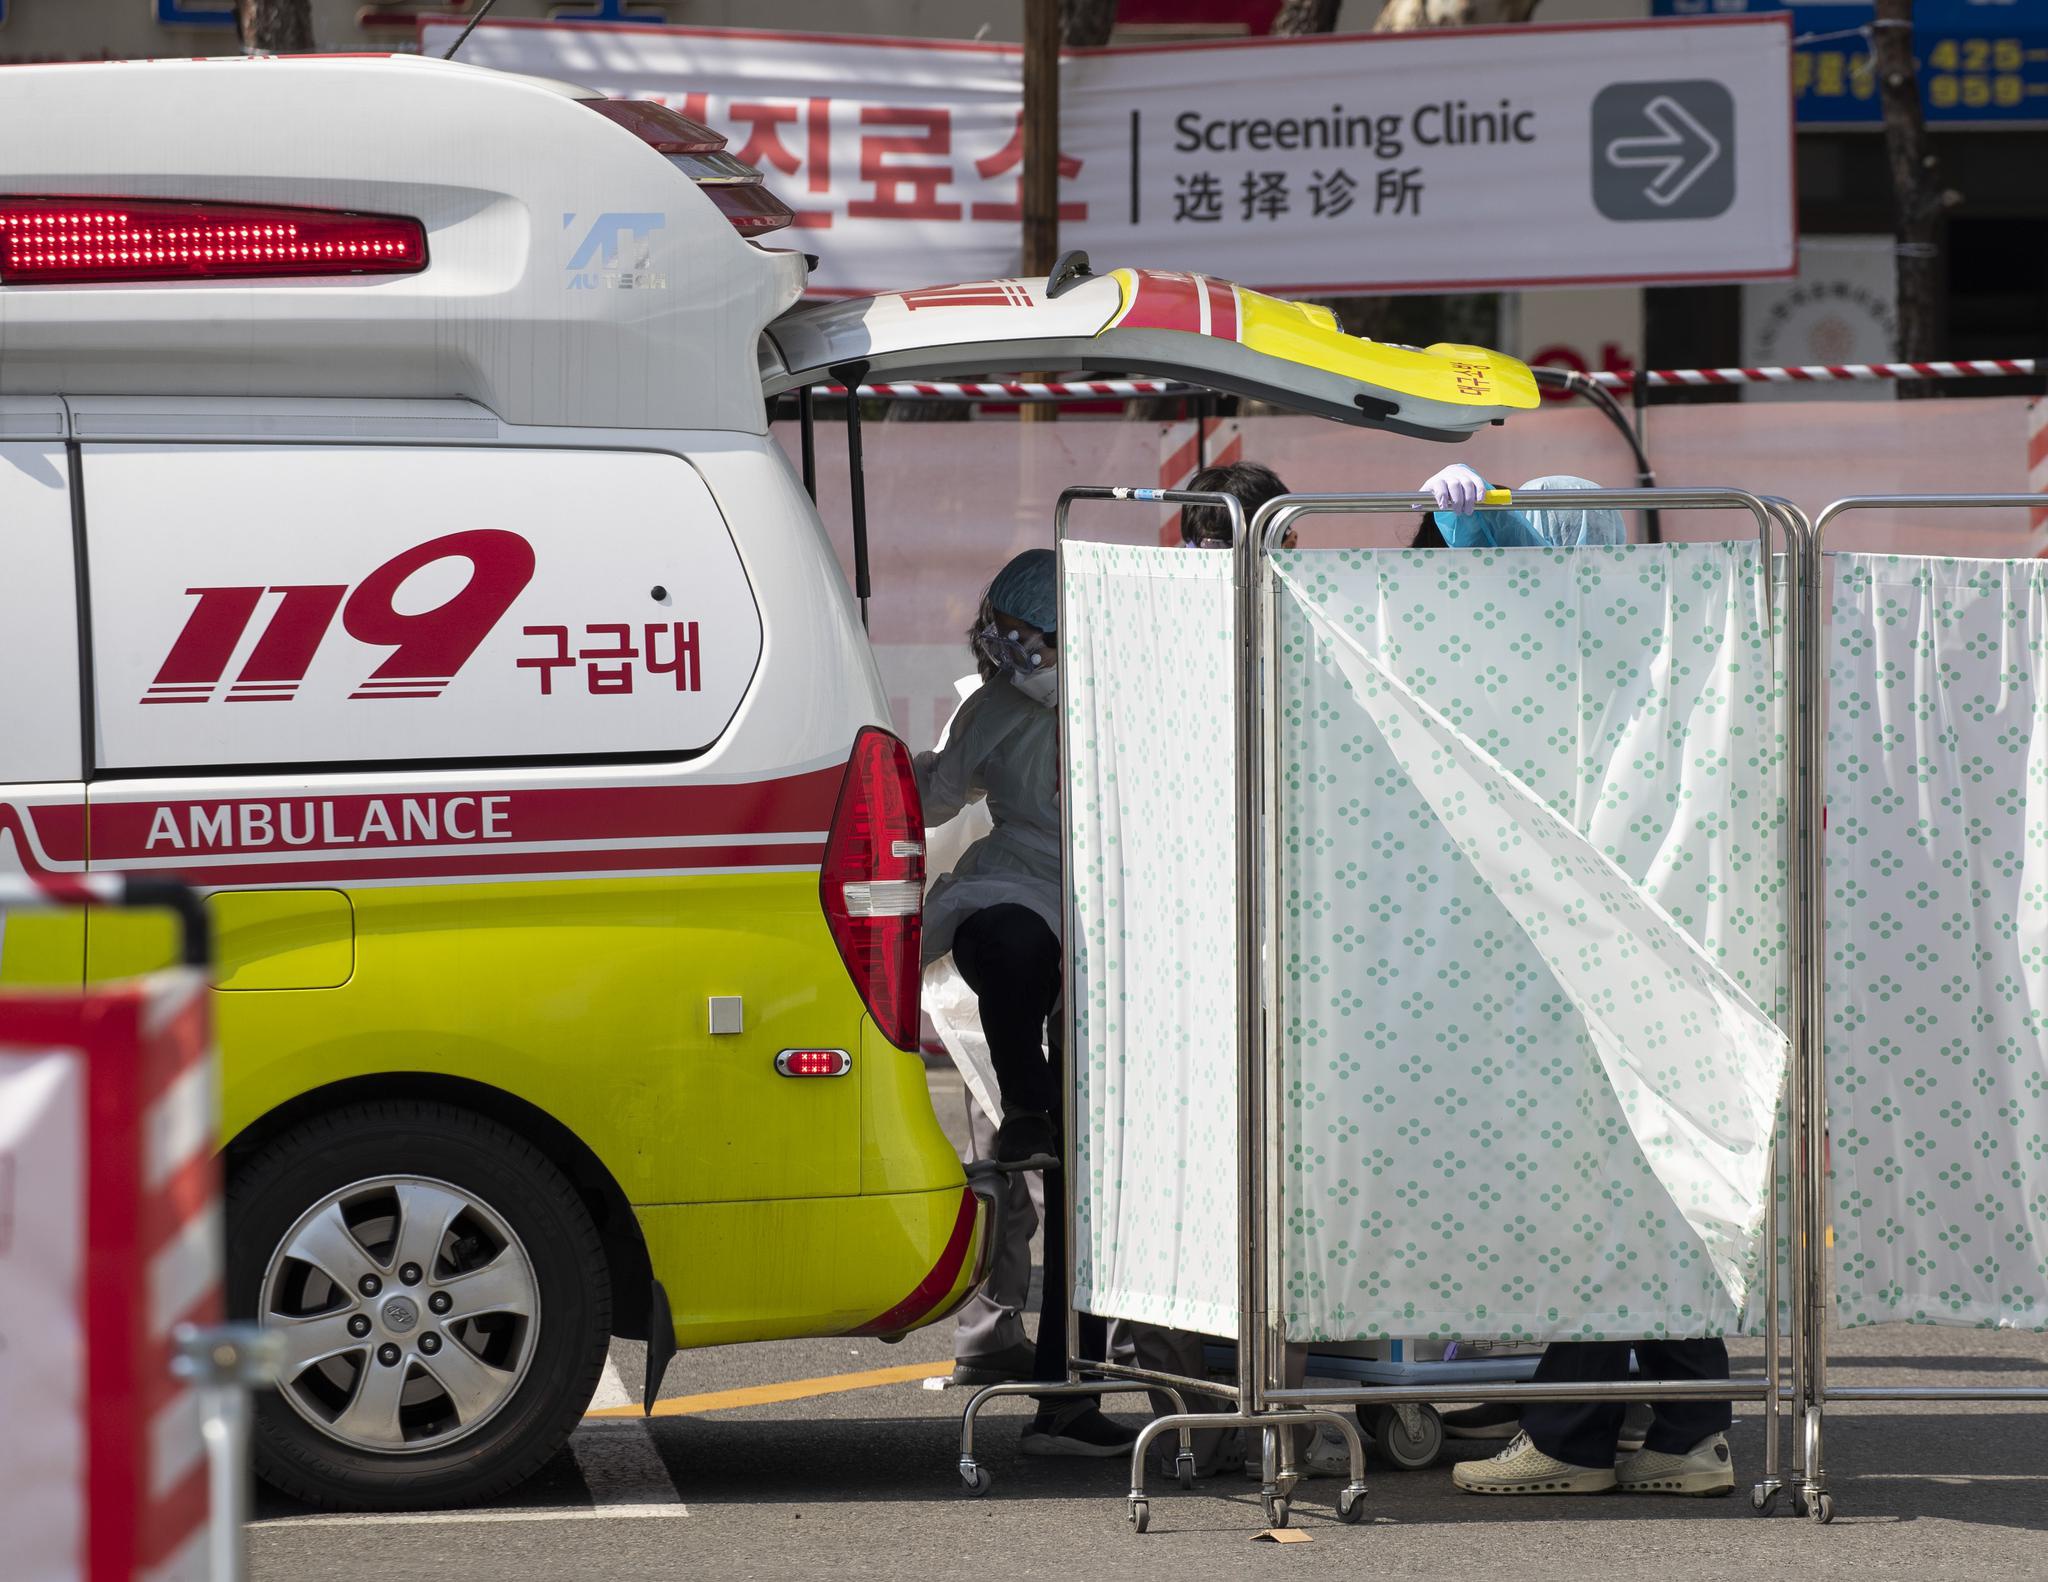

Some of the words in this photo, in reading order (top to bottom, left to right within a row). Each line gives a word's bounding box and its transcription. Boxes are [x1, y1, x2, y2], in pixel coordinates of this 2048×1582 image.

[1174, 104, 1403, 159] Screening
[1412, 99, 1536, 146] Clinic
[610, 92, 1088, 228] 진료소
[1173, 167, 1425, 222] 选择诊所
[138, 528, 535, 704] 119
[516, 621, 702, 695] 구급대
[145, 795, 513, 849] AMBULANCE
